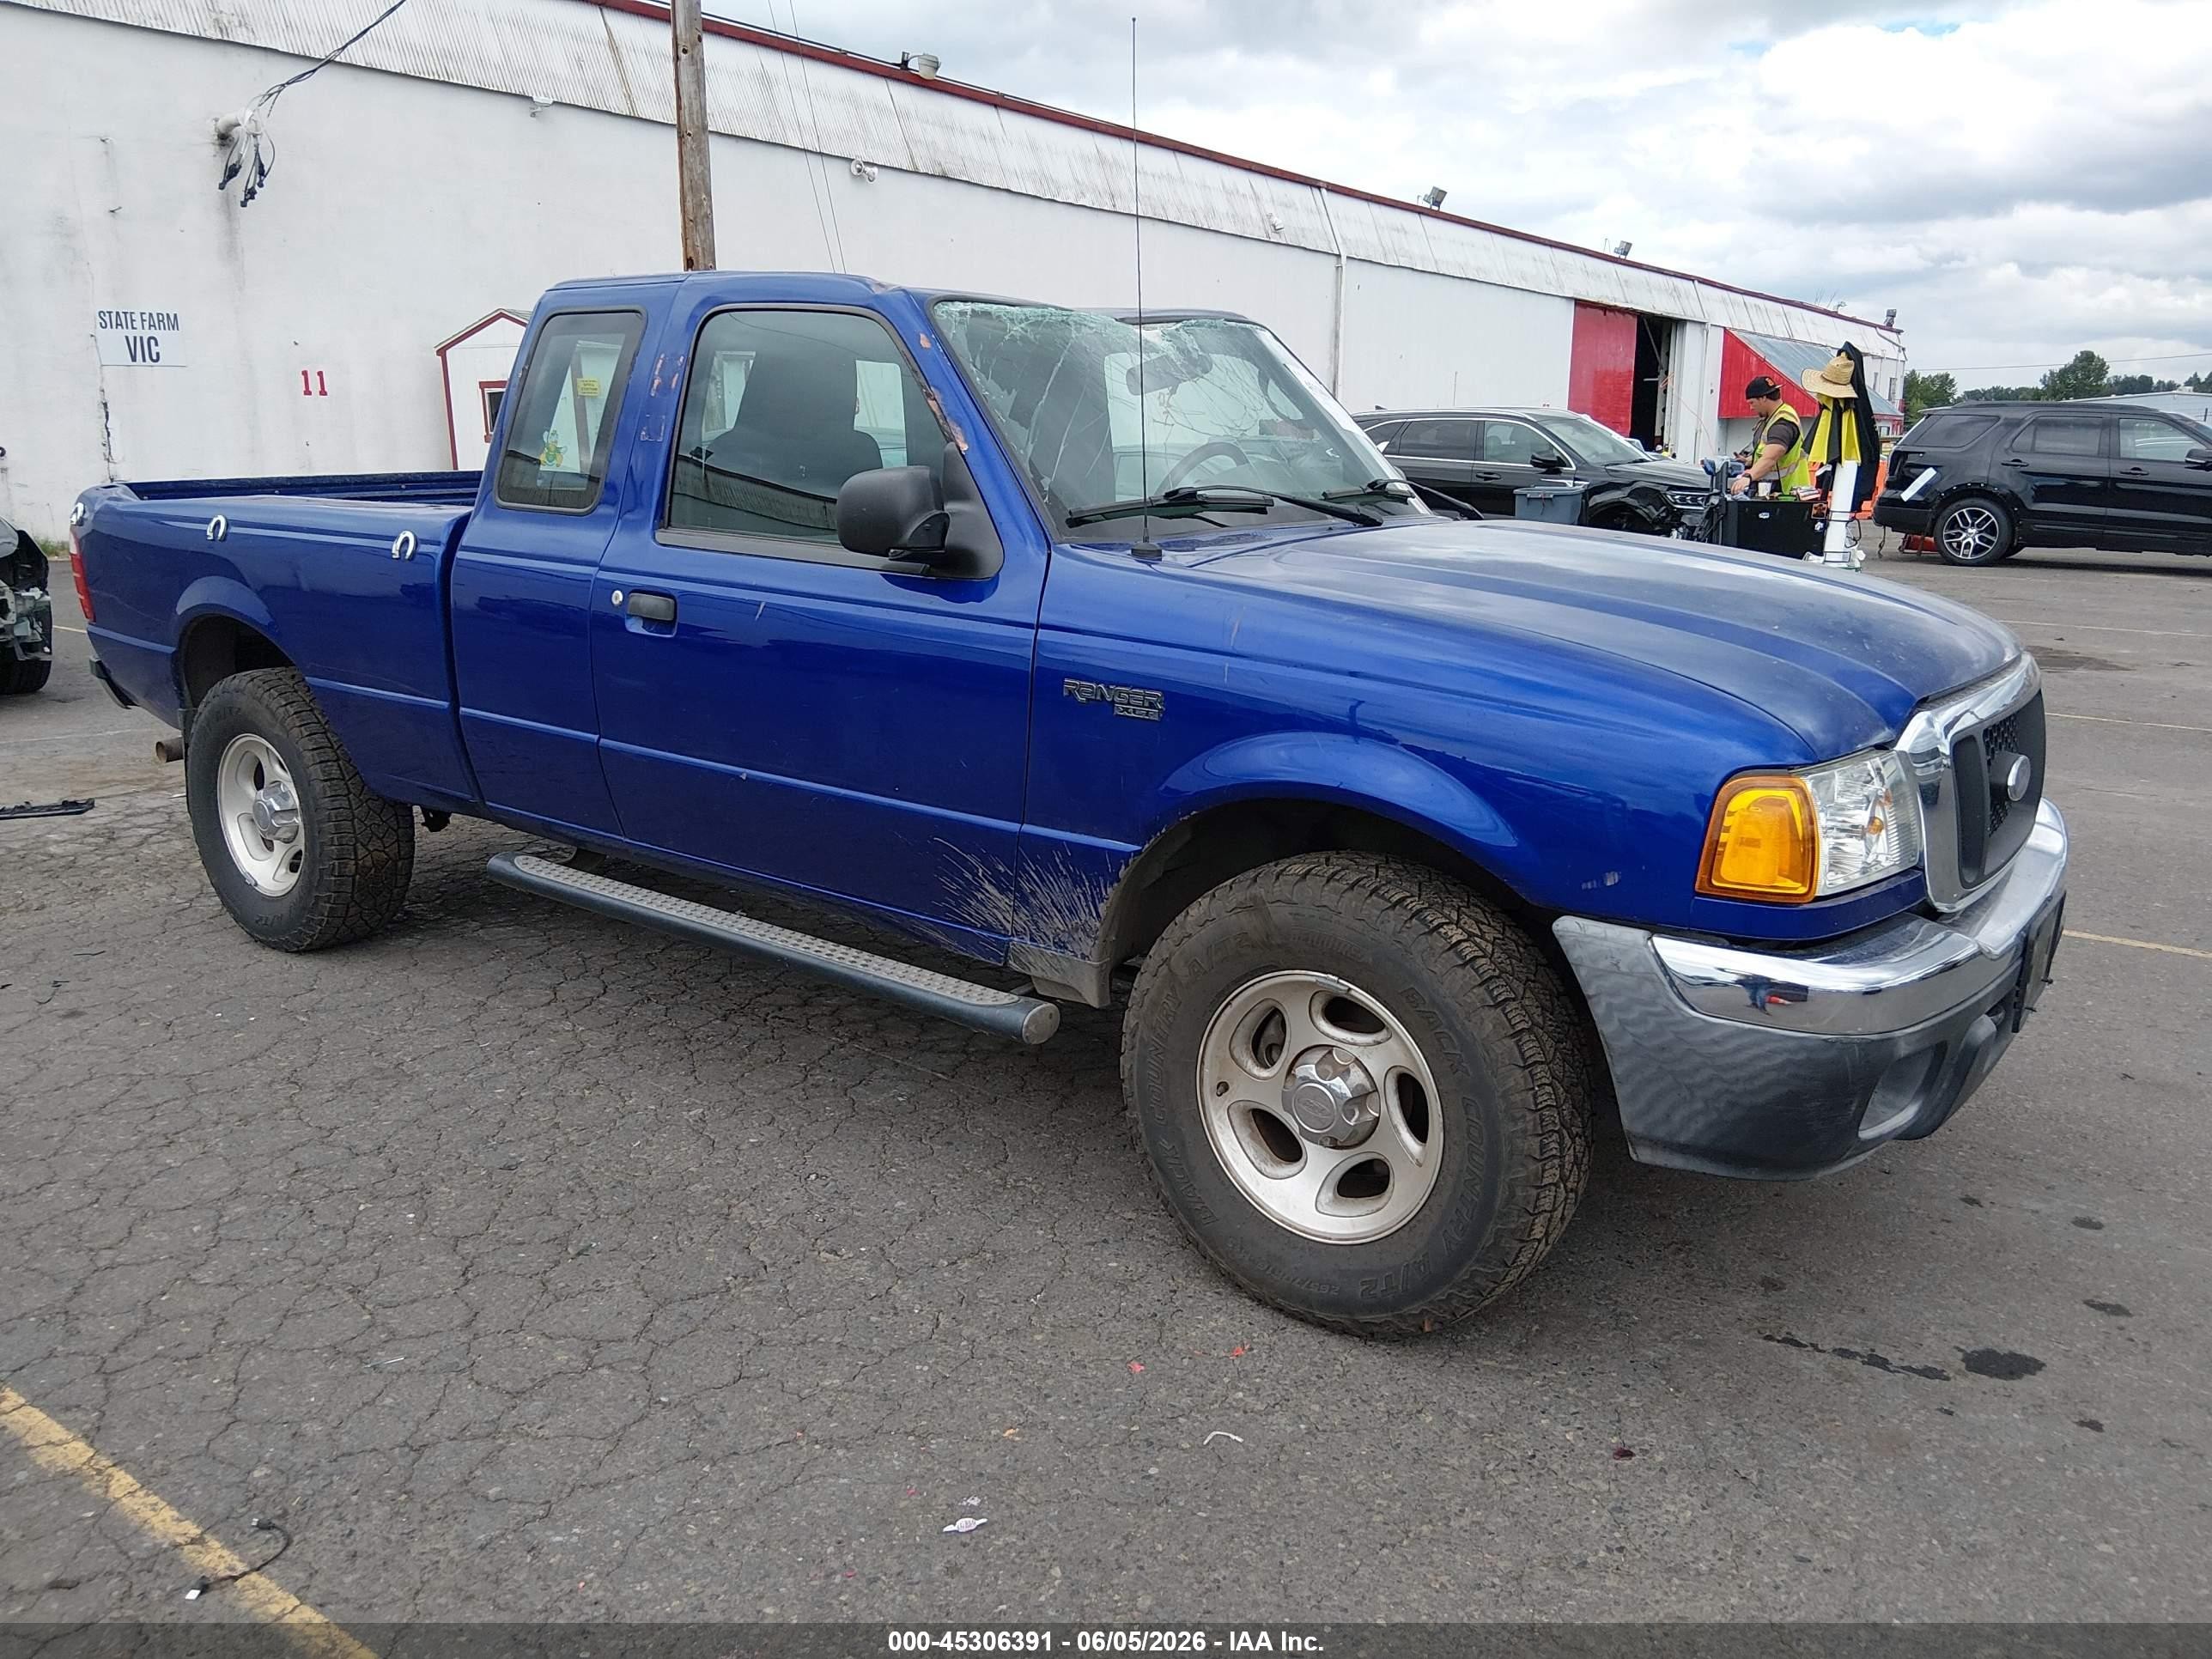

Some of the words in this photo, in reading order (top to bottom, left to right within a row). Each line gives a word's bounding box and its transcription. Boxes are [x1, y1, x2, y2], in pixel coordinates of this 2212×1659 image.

[98, 310, 137, 330] STATE
[140, 312, 179, 331] FARM
[125, 335, 161, 363] VIC
[301, 369, 328, 396] 11
[1064, 678, 1165, 710] RANGER
[1400, 988, 1471, 1077] BACK
